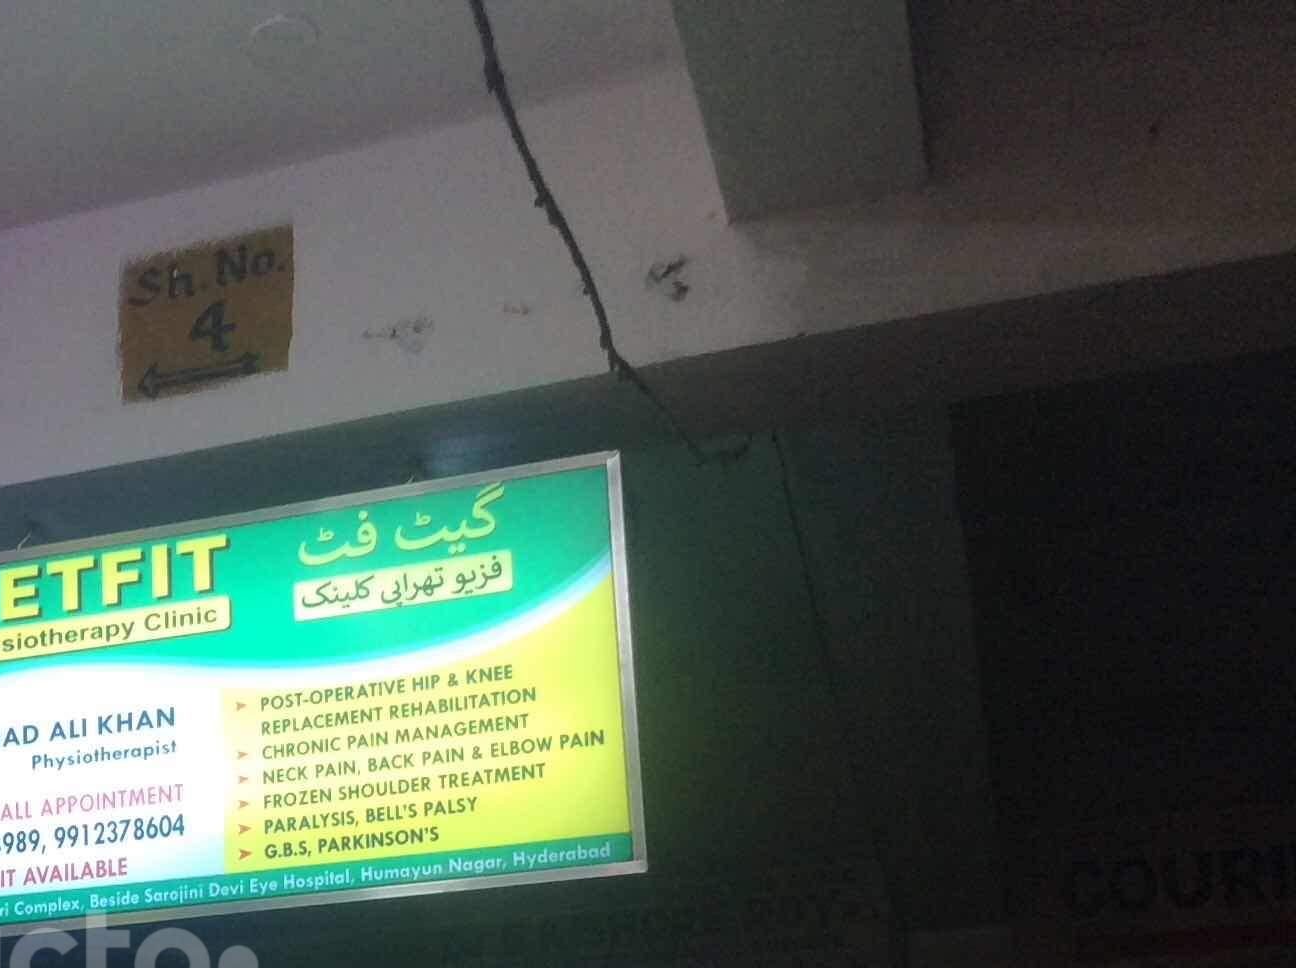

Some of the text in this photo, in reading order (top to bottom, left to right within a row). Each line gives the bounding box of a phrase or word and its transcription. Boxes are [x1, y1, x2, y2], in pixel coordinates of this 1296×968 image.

[188, 300, 236, 352] 4
[297, 482, 505, 567] گیٹ فٹ
[144, 606, 218, 633] Clinic
[260, 664, 514, 713] POST-OPERATIVE HIP & KNEE
[49, 718, 88, 743] ALI
[96, 707, 177, 736] KHAN
[261, 686, 537, 736] REPLACEMENT REHABILITATION
[31, 741, 177, 771] Physiotherapist
[262, 713, 530, 761] CHRONIC PAIN MANAGEMENT
[262, 729, 605, 786] NECK PAIN, BACK PAIN & ELBOW PAIN
[40, 783, 185, 818] APPOINTMENT
[263, 762, 546, 810] FROZEN SHOULDER TREATMENT
[54, 814, 186, 849] 9912378604
[263, 796, 478, 835] PARALYSIS, BELL'S PALSY
[264, 826, 440, 861] G.B.S, PARKINSON'S
[14, 895, 85, 918] Complex,
[90, 888, 140, 909] Beside
[144, 883, 205, 906] Sarojini
[208, 878, 245, 897] Devi
[249, 877, 279, 897] Eye
[283, 867, 355, 892] Hospital,
[360, 861, 443, 884] Humayun
[448, 854, 508, 877] Nagar,
[512, 841, 612, 869] Hyderabad
[23, 857, 128, 887] AVAILABLE
